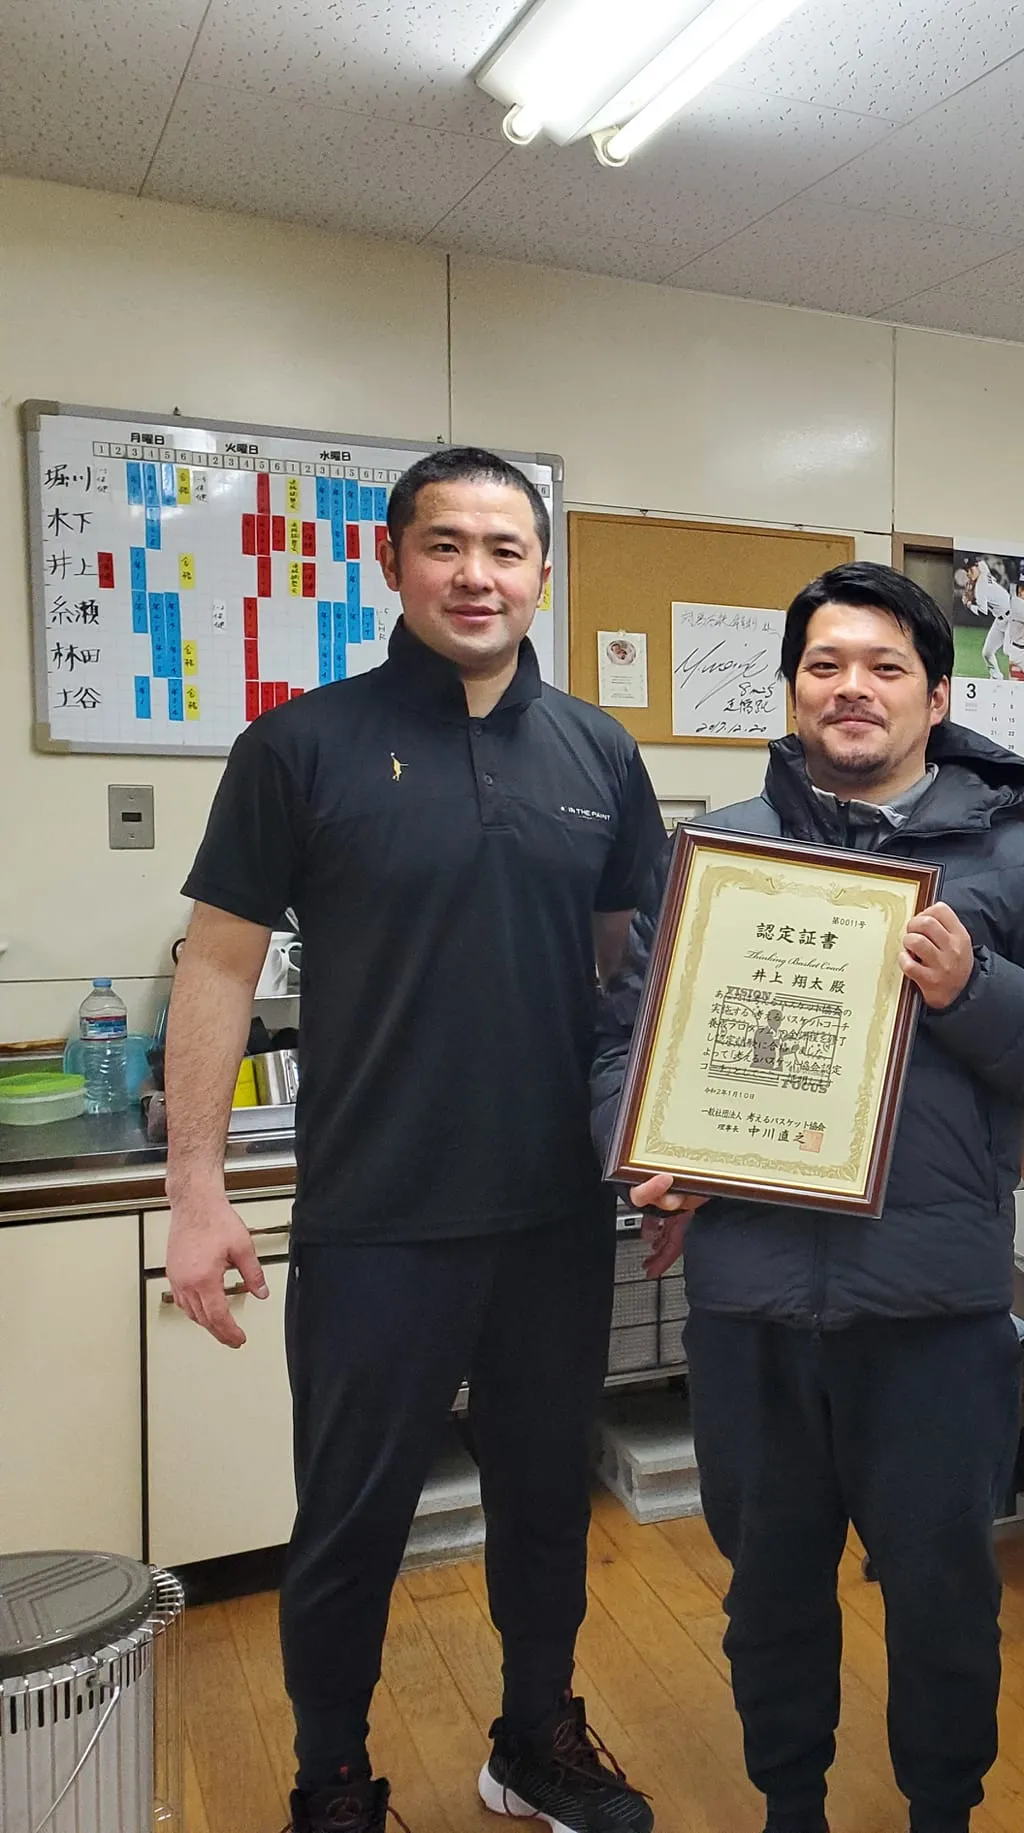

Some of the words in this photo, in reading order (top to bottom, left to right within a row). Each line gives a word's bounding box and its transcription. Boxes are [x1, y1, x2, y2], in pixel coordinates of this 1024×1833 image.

[130, 432, 165, 445] 月曜日
[225, 443, 259, 455] 火曜日
[319, 450, 351, 461] 水曜日
[43, 464, 91, 492] 堀川
[47, 507, 93, 537] 木下
[46, 549, 98, 580] 井上
[50, 595, 100, 625] 糸瀬
[50, 642, 100, 672] 林田
[966, 683, 976, 699] 3
[831, 916, 867, 929] 第0011号
[756, 922, 839, 950] 認定証書
[743, 949, 787, 969] Thinking
[820, 961, 850, 973] Coach
[751, 968, 783, 984] 井上
[791, 973, 823, 991] 翔太
[829, 979, 845, 994] 殿
[704, 1086, 755, 1100] 令和2年1月10日
[701, 1107, 742, 1121] 一般社団法人
[746, 1112, 827, 1132] 考えるバスケット協会
[717, 1123, 740, 1133] 理事長
[748, 1125, 806, 1145] 中川直之
